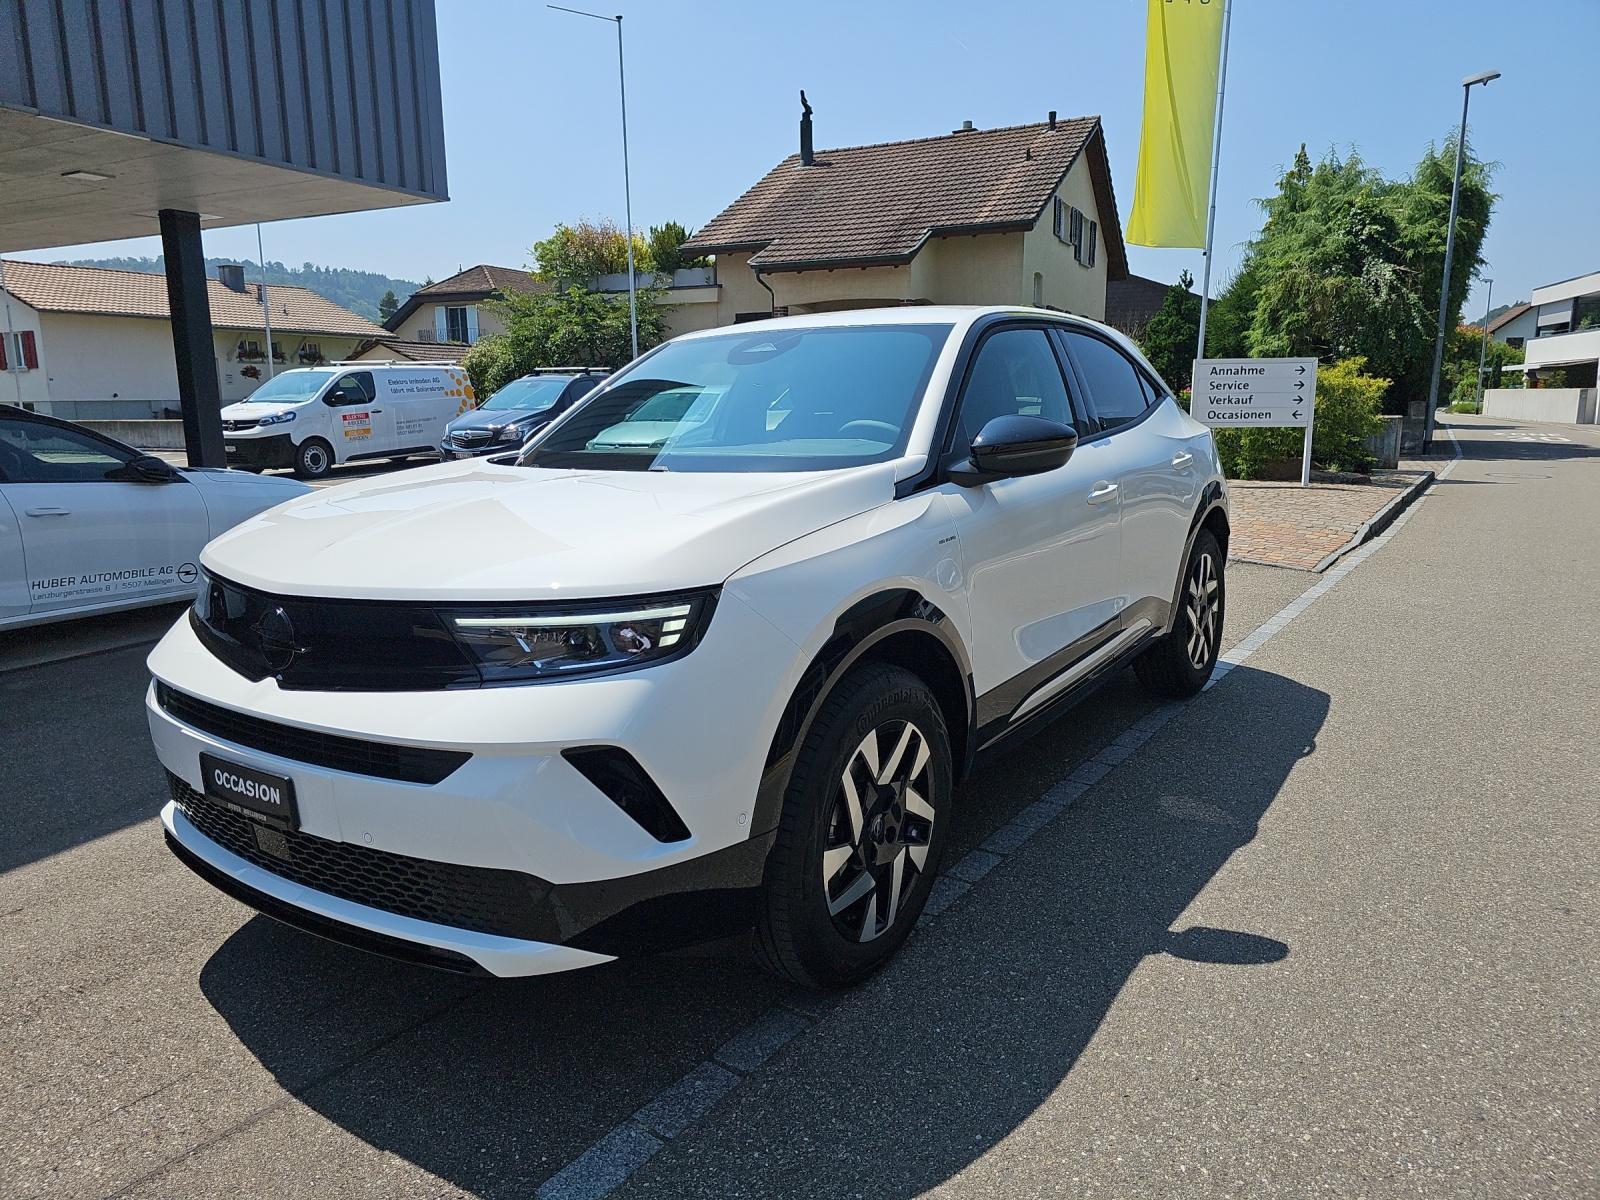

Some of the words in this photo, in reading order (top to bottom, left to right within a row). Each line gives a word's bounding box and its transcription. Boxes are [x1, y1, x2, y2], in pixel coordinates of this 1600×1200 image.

[1209, 365, 1266, 376] Annahme
[432, 376, 441, 384] AG
[1209, 380, 1250, 391] Service
[1208, 394, 1254, 405] Verkauf
[1207, 409, 1272, 420] Occasionen
[31, 576, 76, 591] HUBER
[79, 568, 155, 585] AUTOMOBILE
[158, 565, 174, 576] AG
[32, 586, 104, 601] Lenzburgerstrasse
[105, 584, 111, 592] 8
[121, 580, 143, 590] 5507
[143, 578, 175, 589] Mellingen
[214, 768, 281, 805] OCCASION
